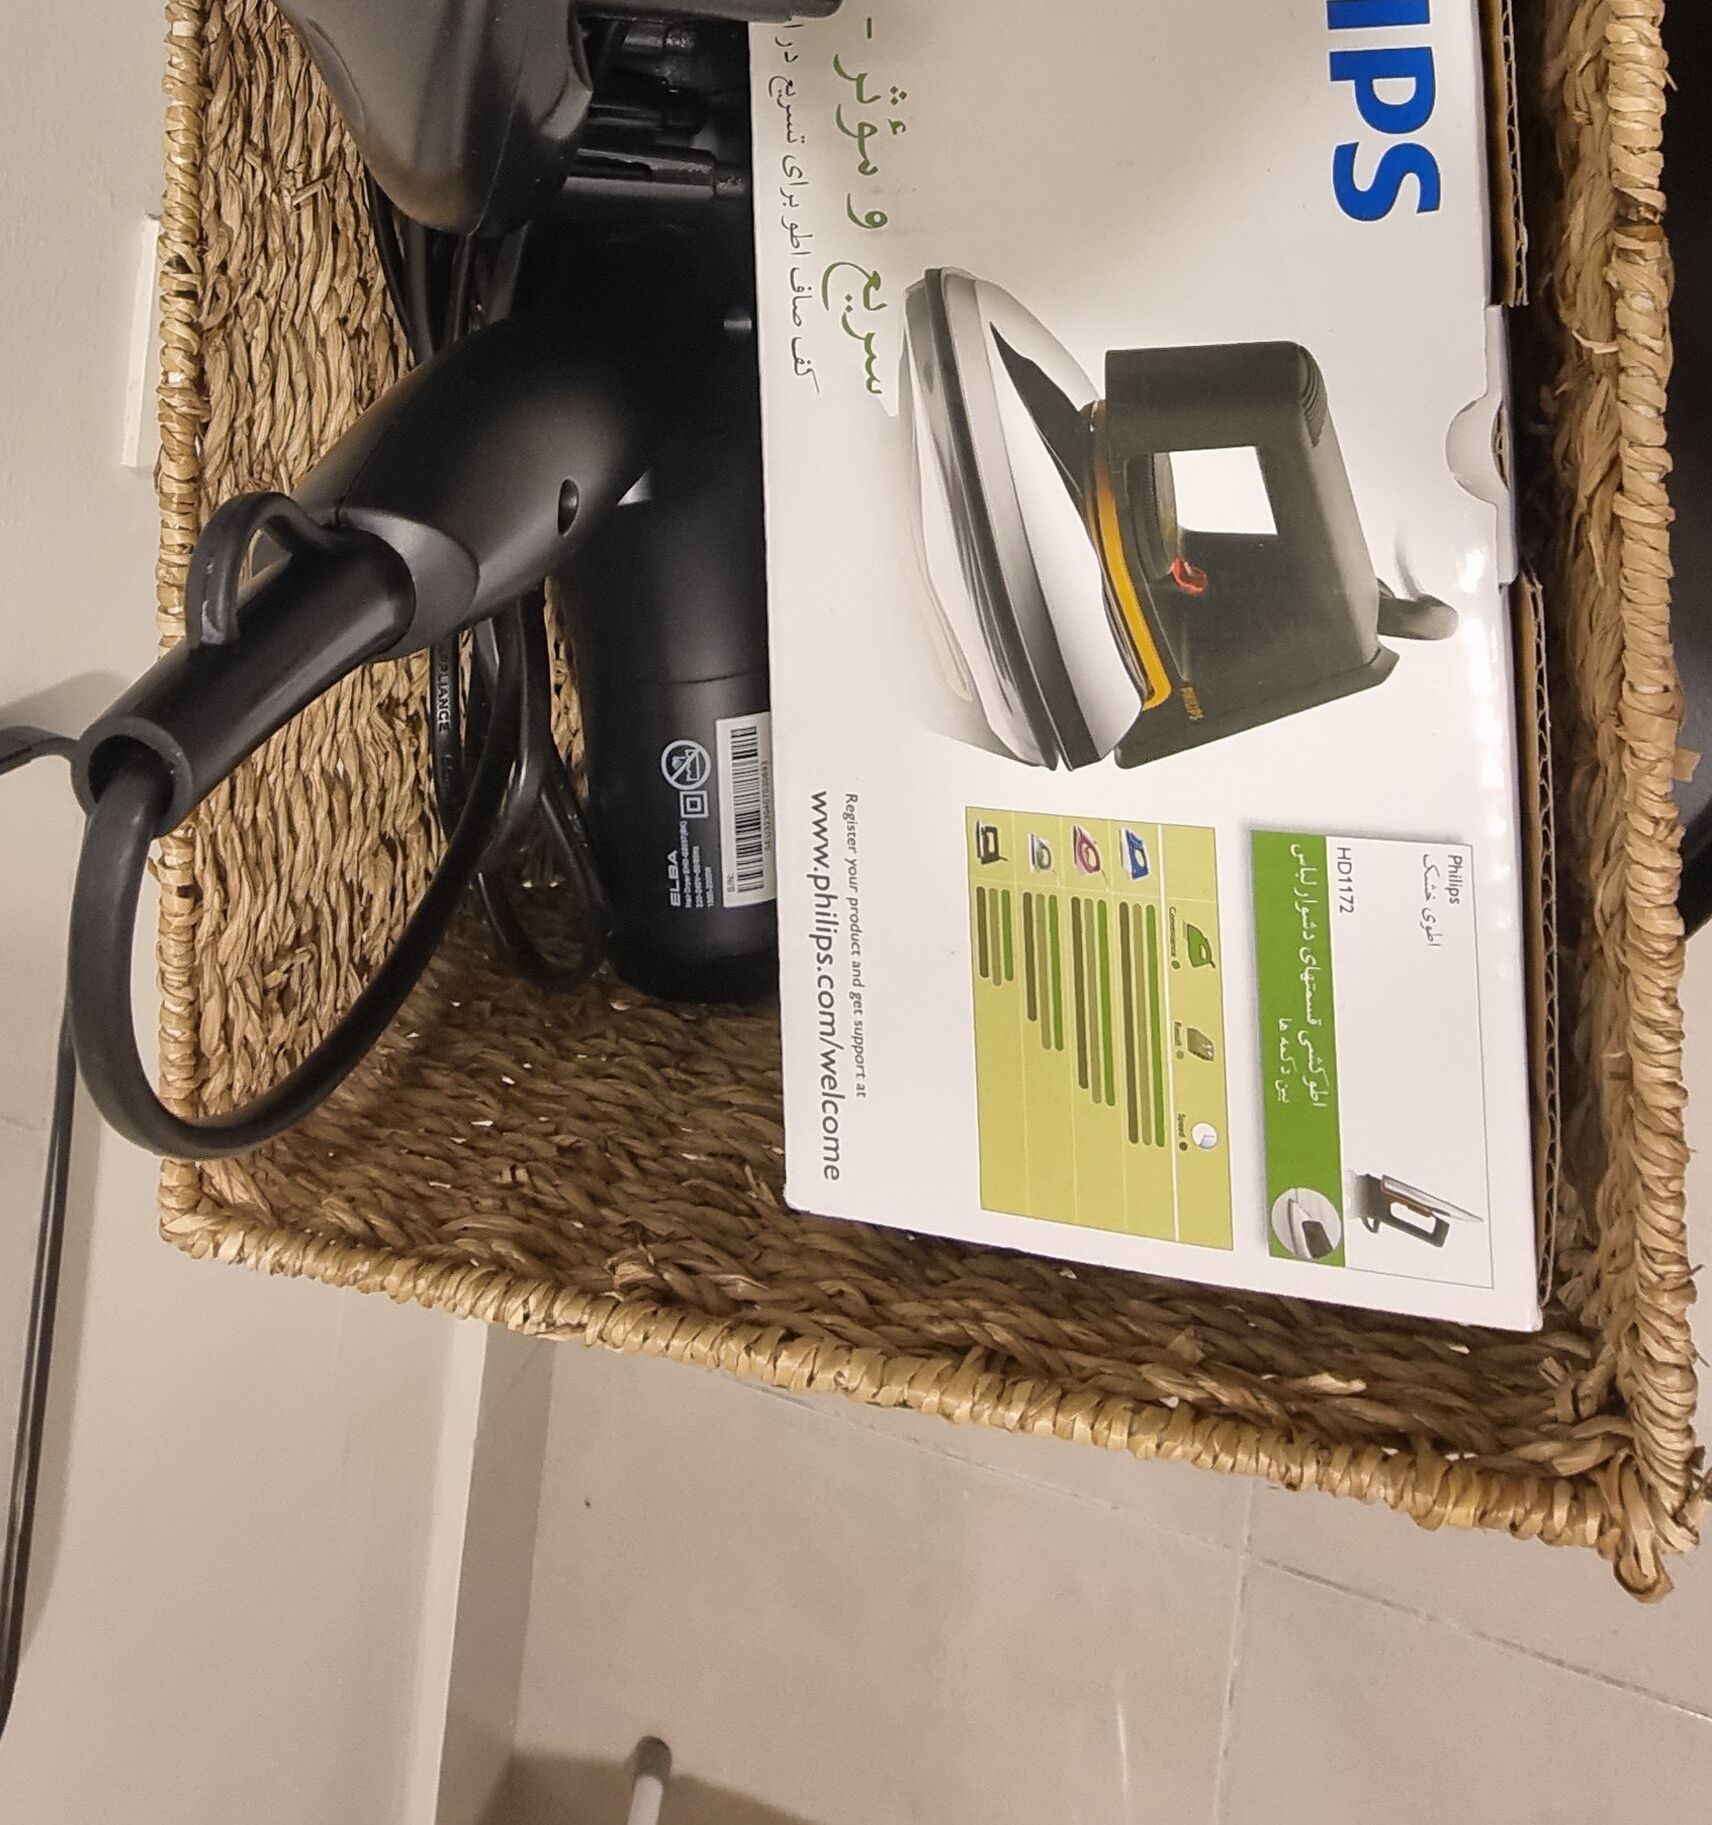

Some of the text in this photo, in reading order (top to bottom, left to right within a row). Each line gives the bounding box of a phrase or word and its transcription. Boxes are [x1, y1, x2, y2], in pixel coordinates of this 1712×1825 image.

[768, 75, 806, 144] تسریع
[832, 52, 908, 176] مؤثر
[779, 154, 809, 208] برای
[780, 215, 814, 256] اطو
[846, 193, 889, 230] و
[789, 267, 813, 328] صاف
[820, 258, 890, 397] سریع
[791, 336, 820, 393] کف
[1180, 686, 1203, 721] PHILIPS
[668, 849, 680, 906] ELBA
[683, 874, 691, 892] Dryer
[1290, 843, 1316, 885] لباس
[1336, 846, 1355, 914] HD1172
[1444, 854, 1464, 905] Philips
[1293, 887, 1318, 942] دشوار
[1419, 853, 1443, 947] اطوی خشک
[842, 793, 867, 1098] Register your product and get support at
[806, 790, 846, 1182] www.philips.com/welcome
[1279, 1036, 1297, 1075] دکمه
[1177, 1113, 1187, 1138] Speed
